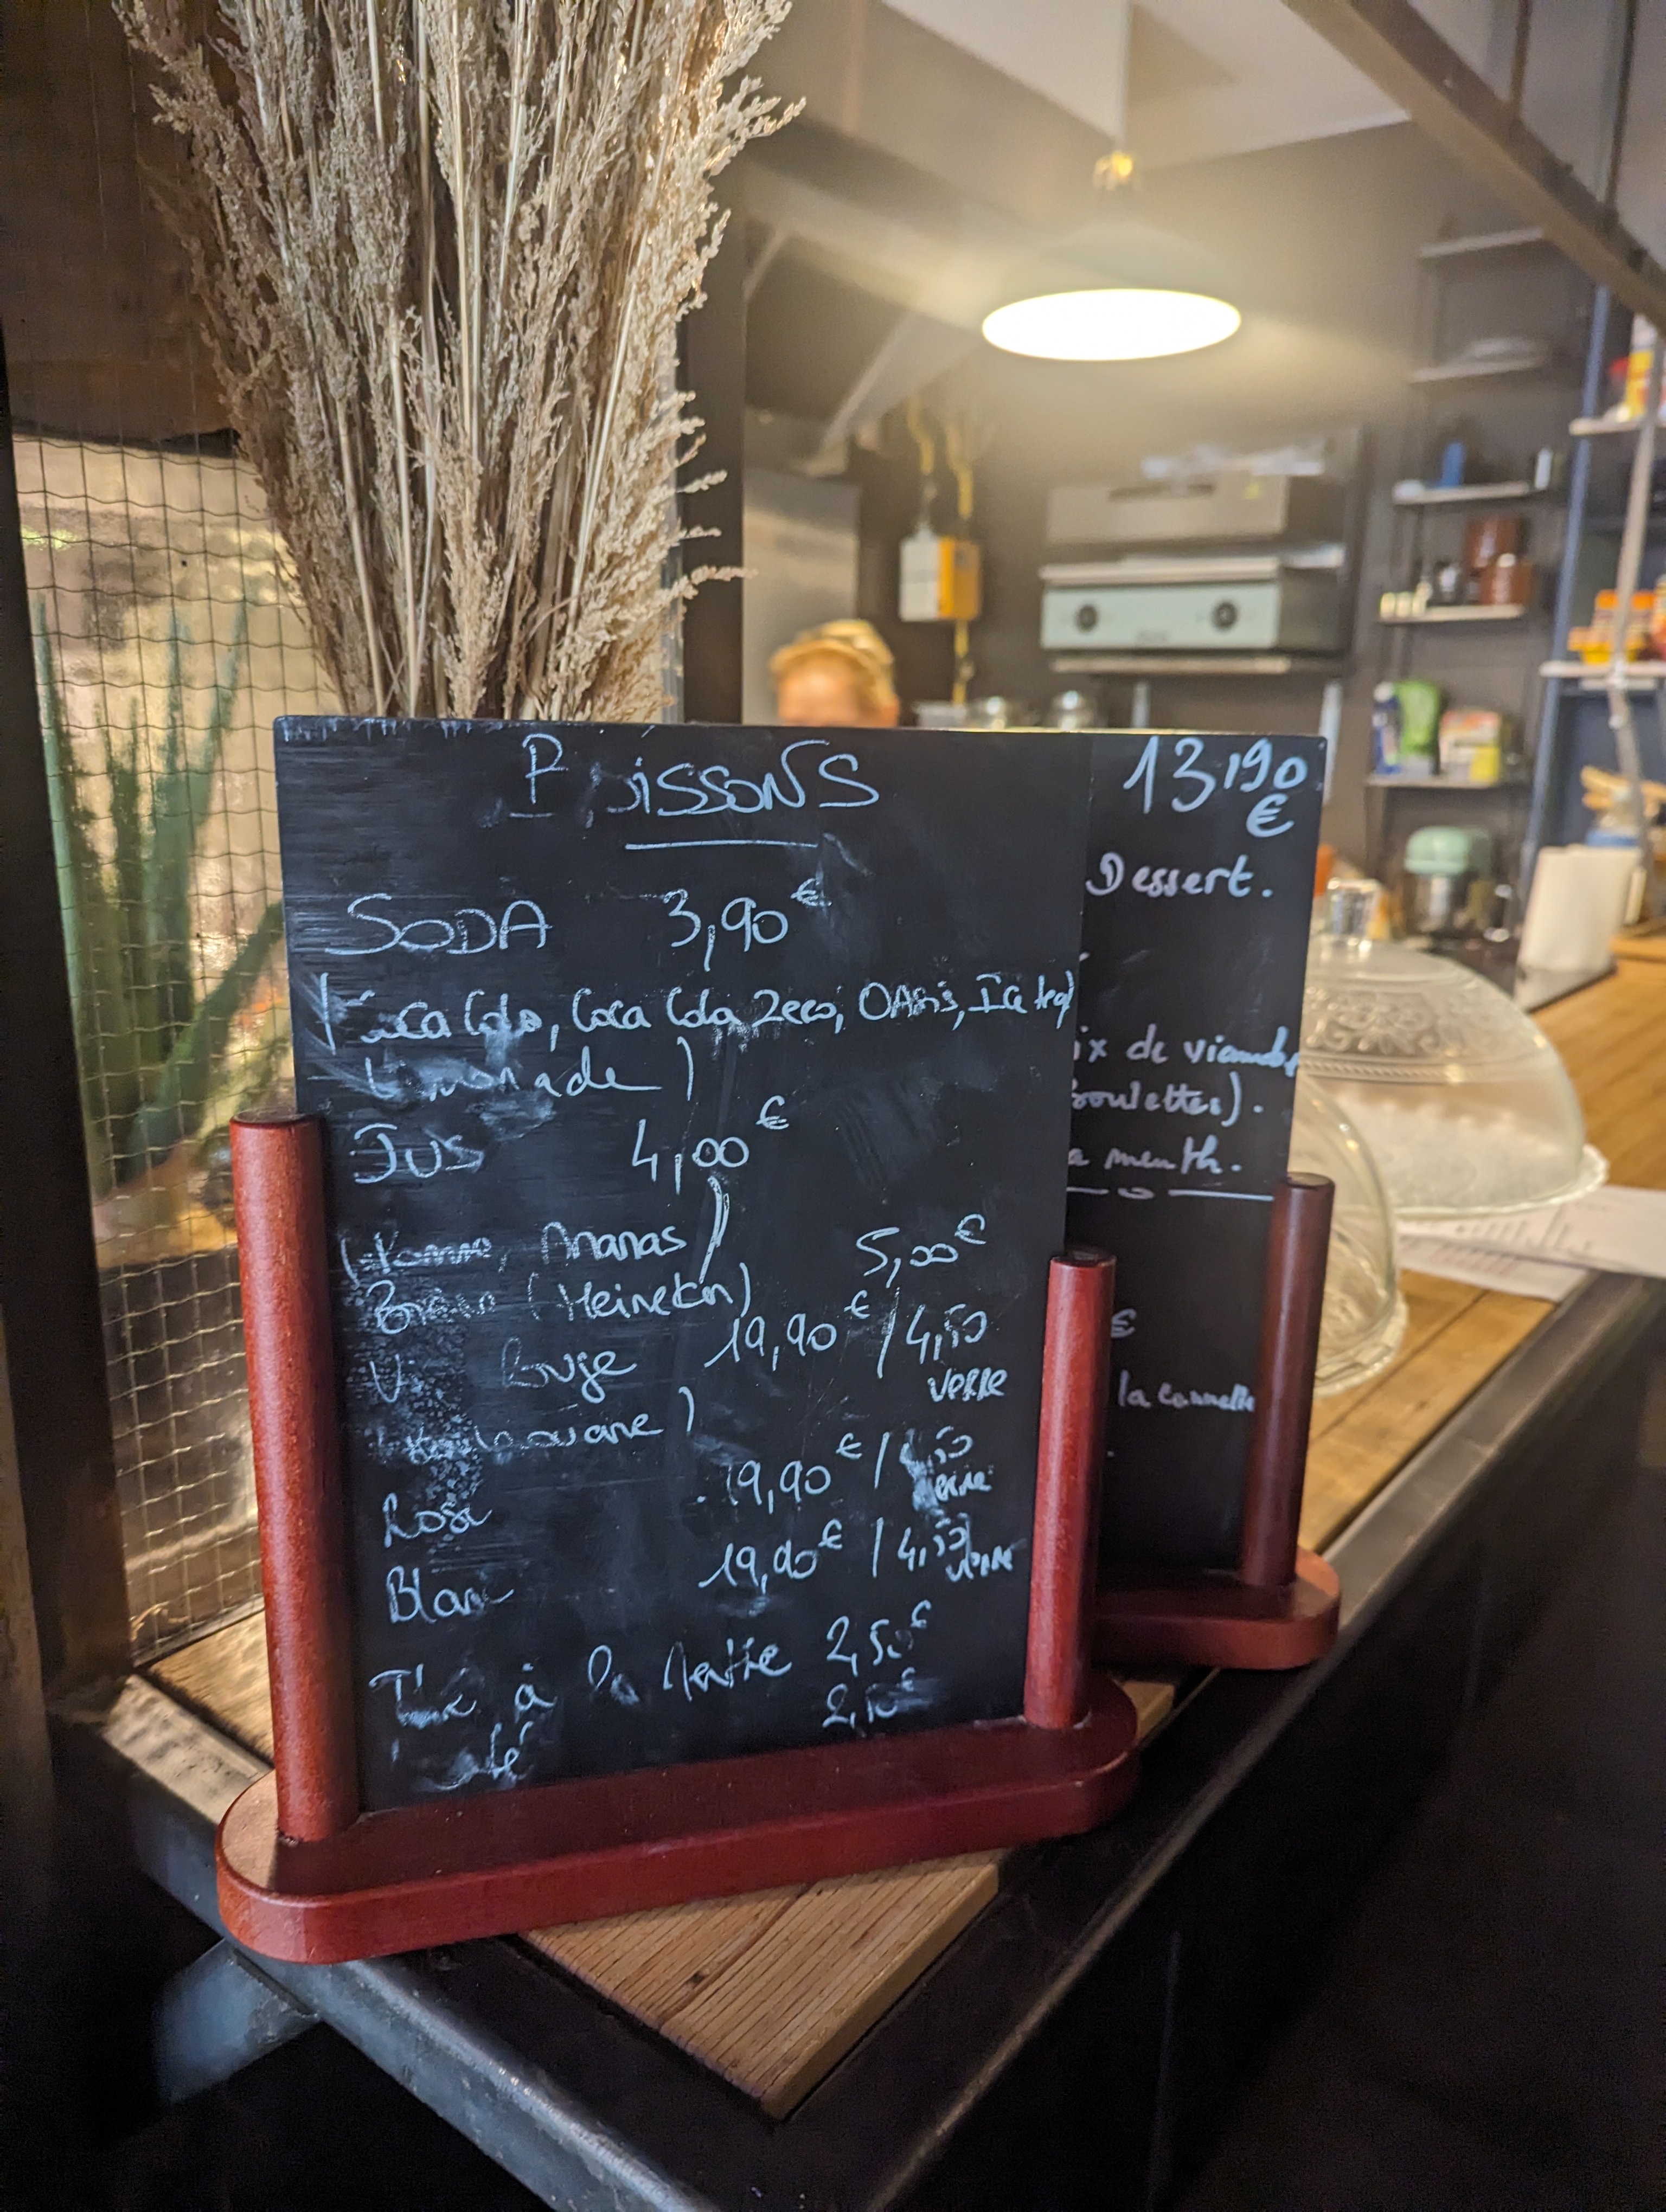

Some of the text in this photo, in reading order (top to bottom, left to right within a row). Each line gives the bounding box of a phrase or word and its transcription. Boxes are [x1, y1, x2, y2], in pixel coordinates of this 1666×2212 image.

[1246, 793, 1295, 838] €
[1086, 852, 1273, 898] Dessert.
[572, 987, 651, 1033] Coca
[666, 986, 742, 1028] Cola
[1126, 1023, 1169, 1064] de
[1118, 1369, 1152, 1409] la
[915, 1470, 993, 1512] erre
